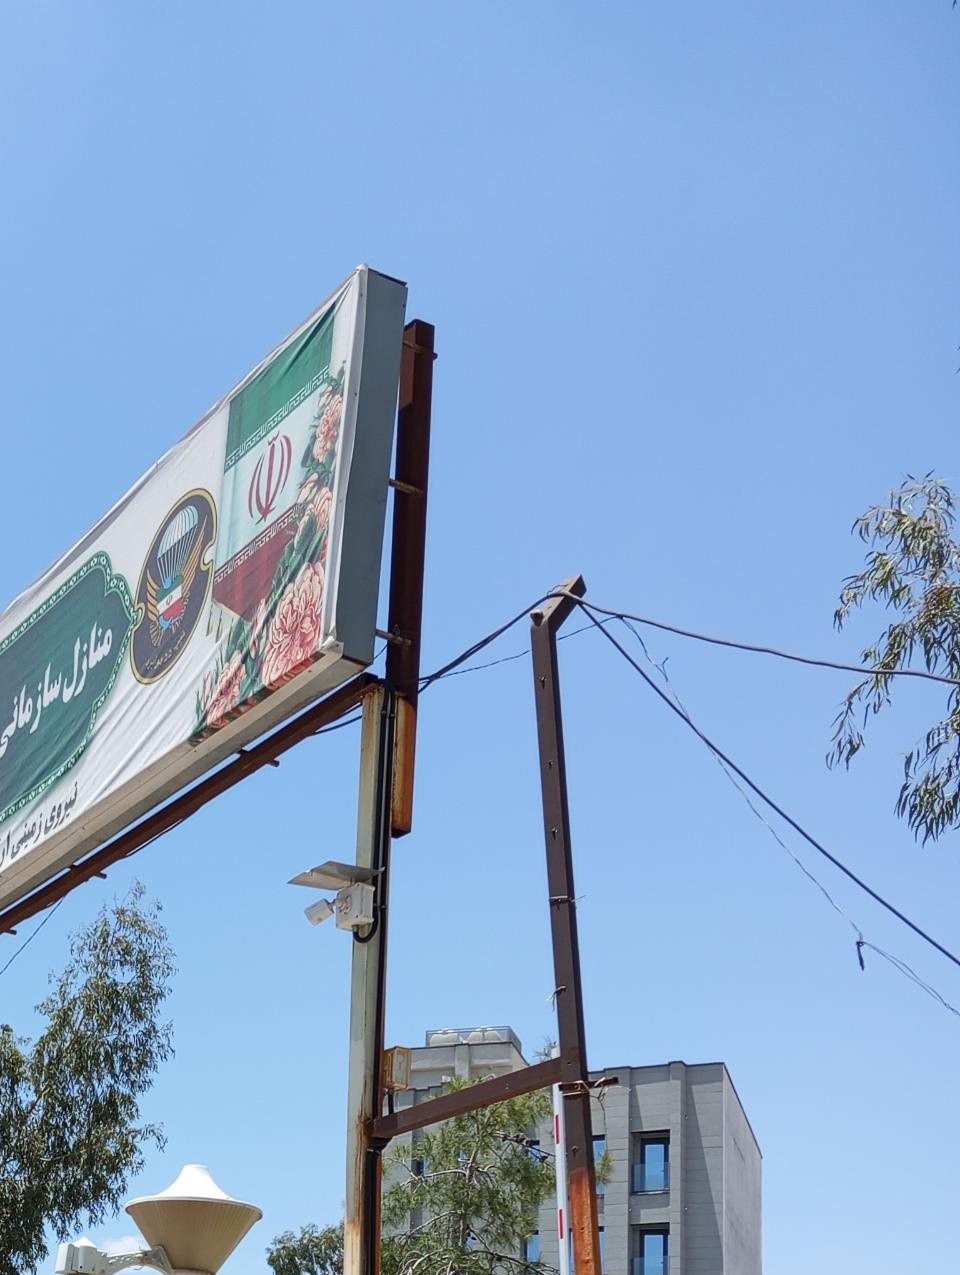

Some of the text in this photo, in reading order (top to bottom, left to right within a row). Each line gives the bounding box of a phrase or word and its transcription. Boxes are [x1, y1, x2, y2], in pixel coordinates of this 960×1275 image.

[62, 621, 113, 704] منازل
[44, 781, 78, 836] نیروی
[11, 813, 43, 860] زمینی
